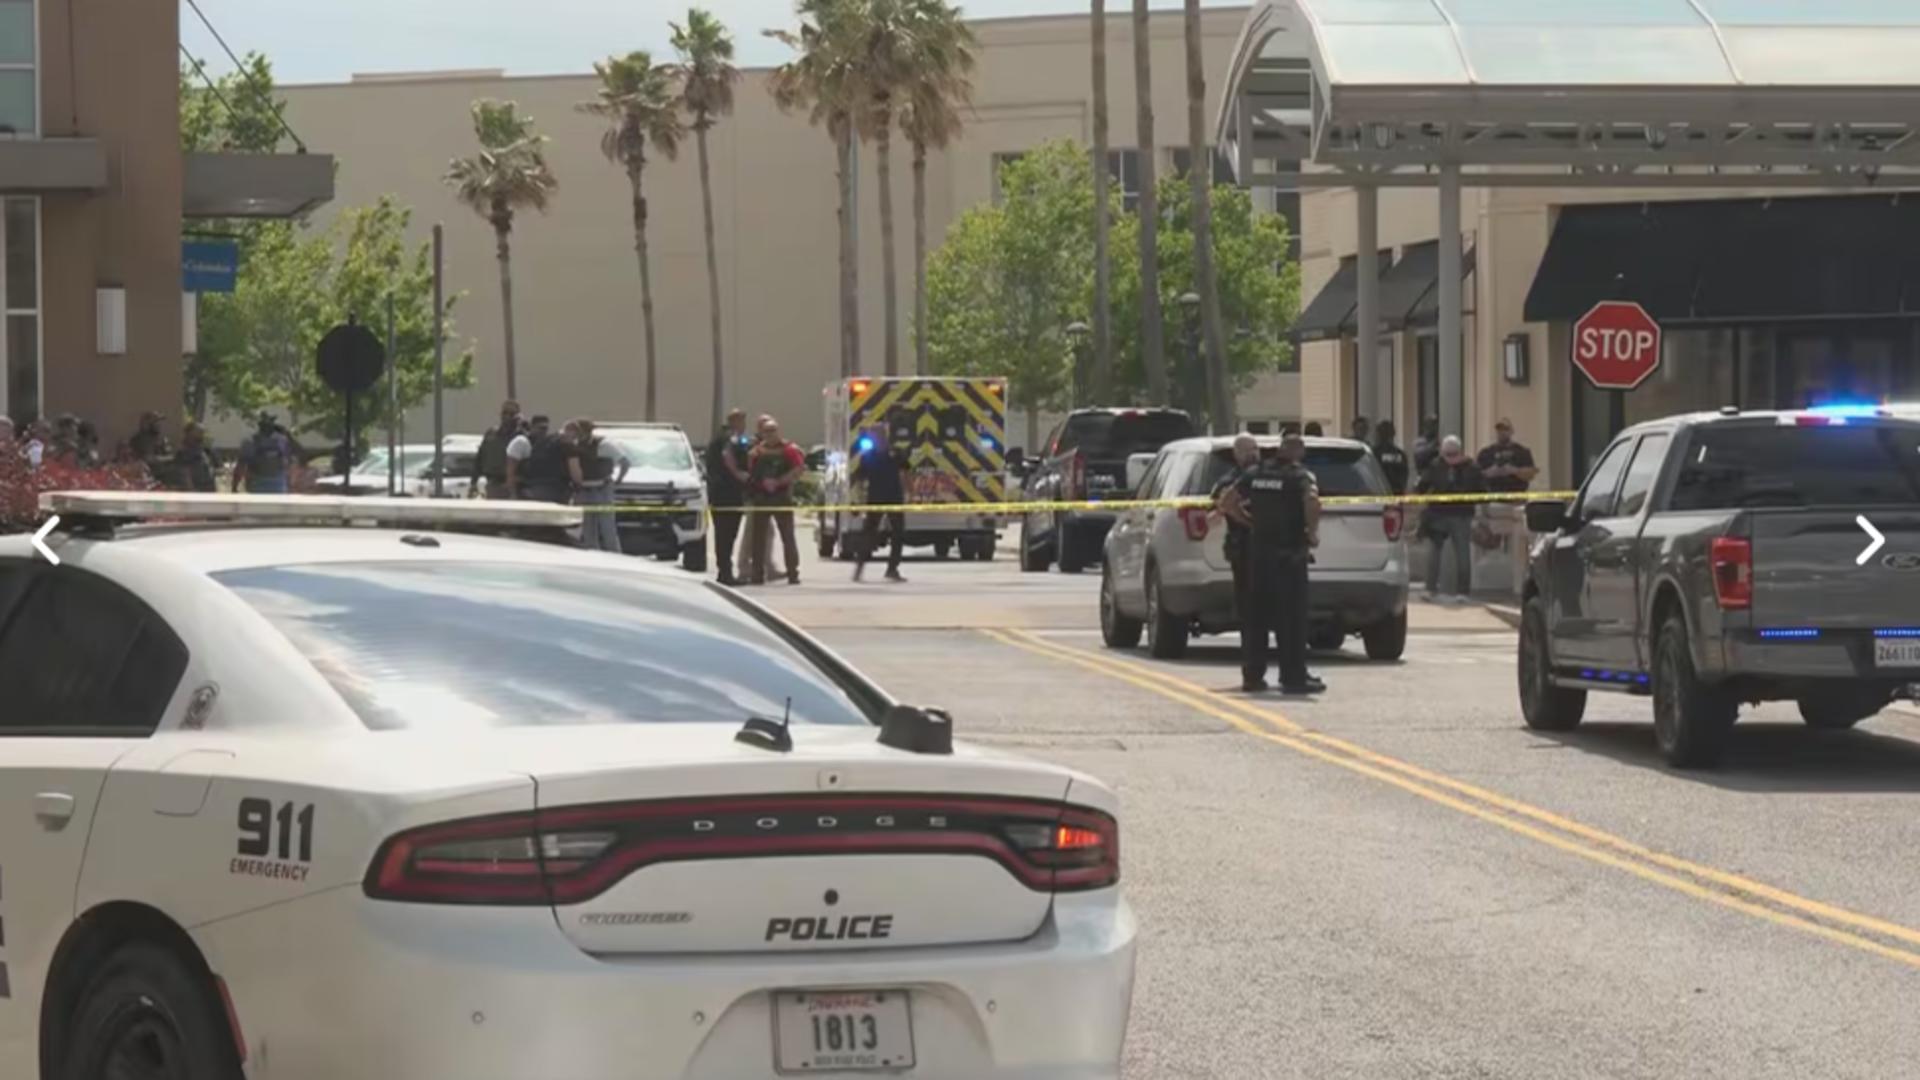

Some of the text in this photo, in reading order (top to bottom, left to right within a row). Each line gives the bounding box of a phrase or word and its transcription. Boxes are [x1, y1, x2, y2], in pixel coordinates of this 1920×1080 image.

[1580, 327, 1654, 361] STOP
[238, 797, 315, 862] 911
[693, 815, 947, 831] DODGE
[230, 858, 309, 881] EMERGENCY
[765, 914, 894, 942] POLICE
[812, 1014, 878, 1052] 1813
